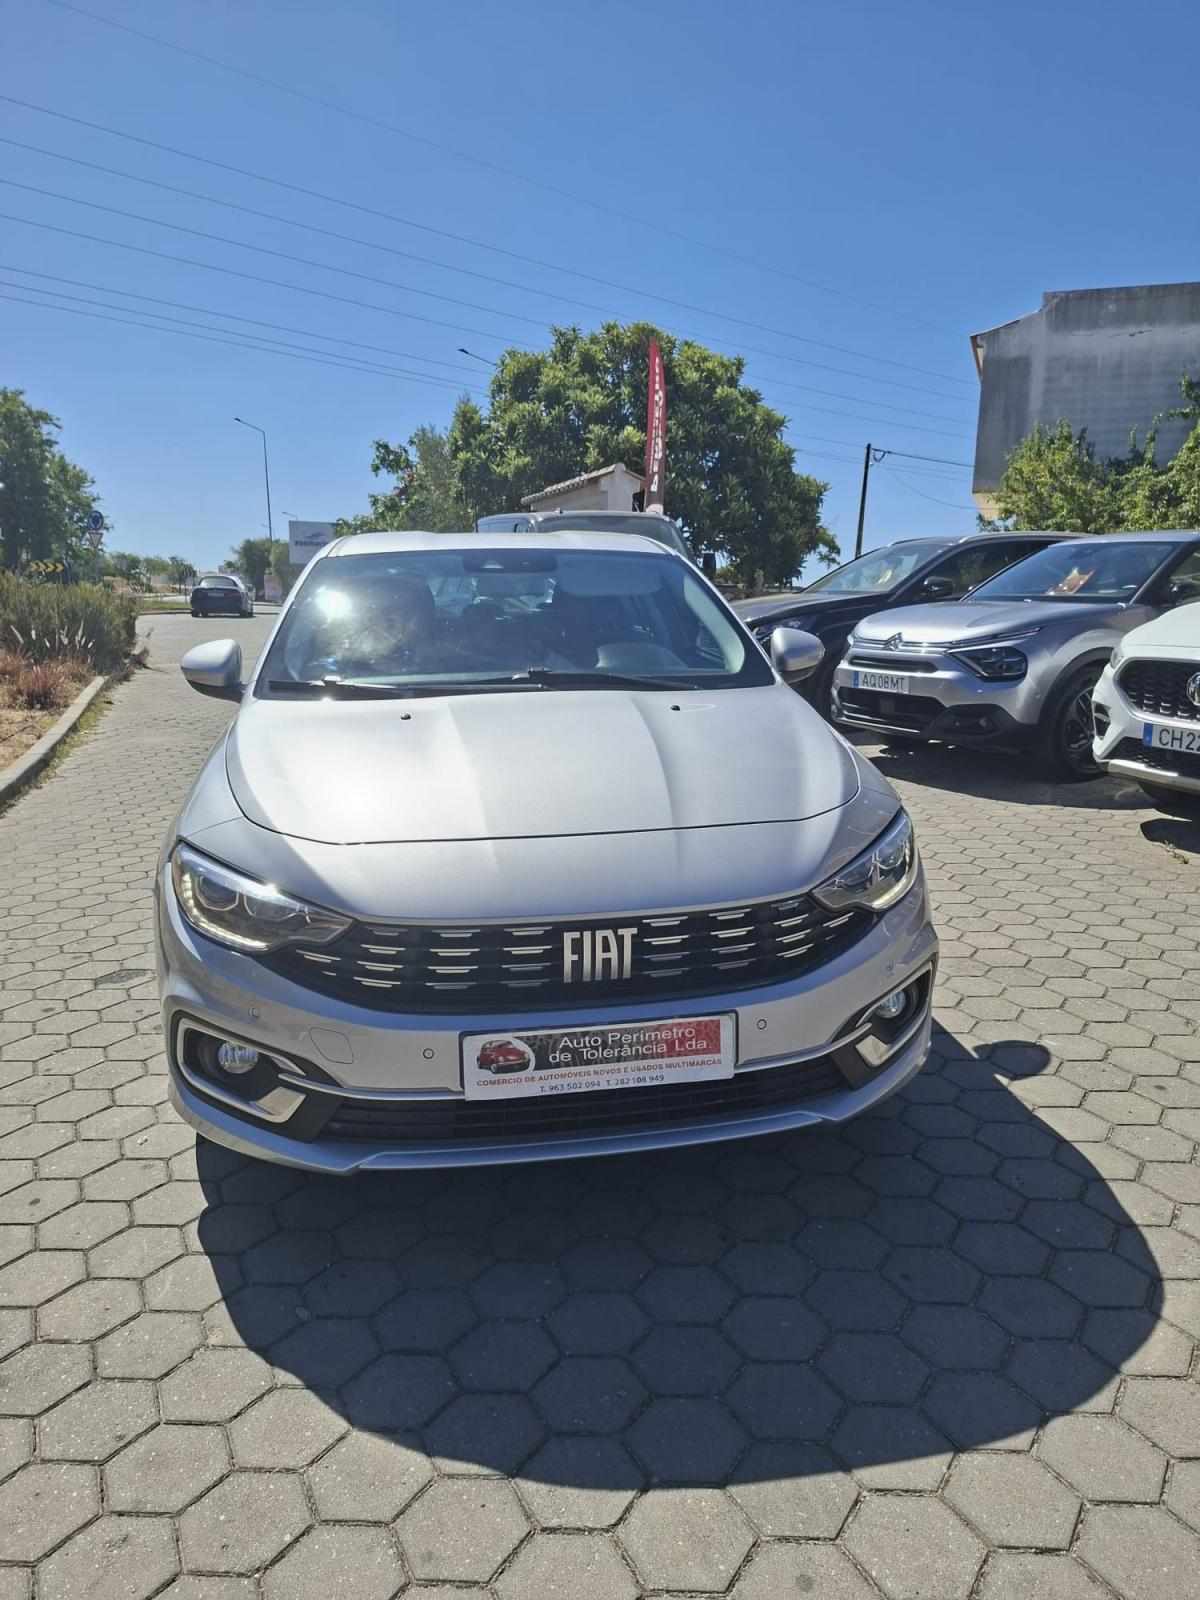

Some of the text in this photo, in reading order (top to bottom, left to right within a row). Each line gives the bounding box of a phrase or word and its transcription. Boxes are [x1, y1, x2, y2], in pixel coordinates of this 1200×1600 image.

[563, 927, 638, 983] FIAT
[559, 1035, 601, 1049] Auto
[549, 1050, 572, 1063] de
[579, 1040, 668, 1060] Tolerância
[593, 1067, 621, 1076] NOVOS
[630, 1063, 664, 1073] USADOS
